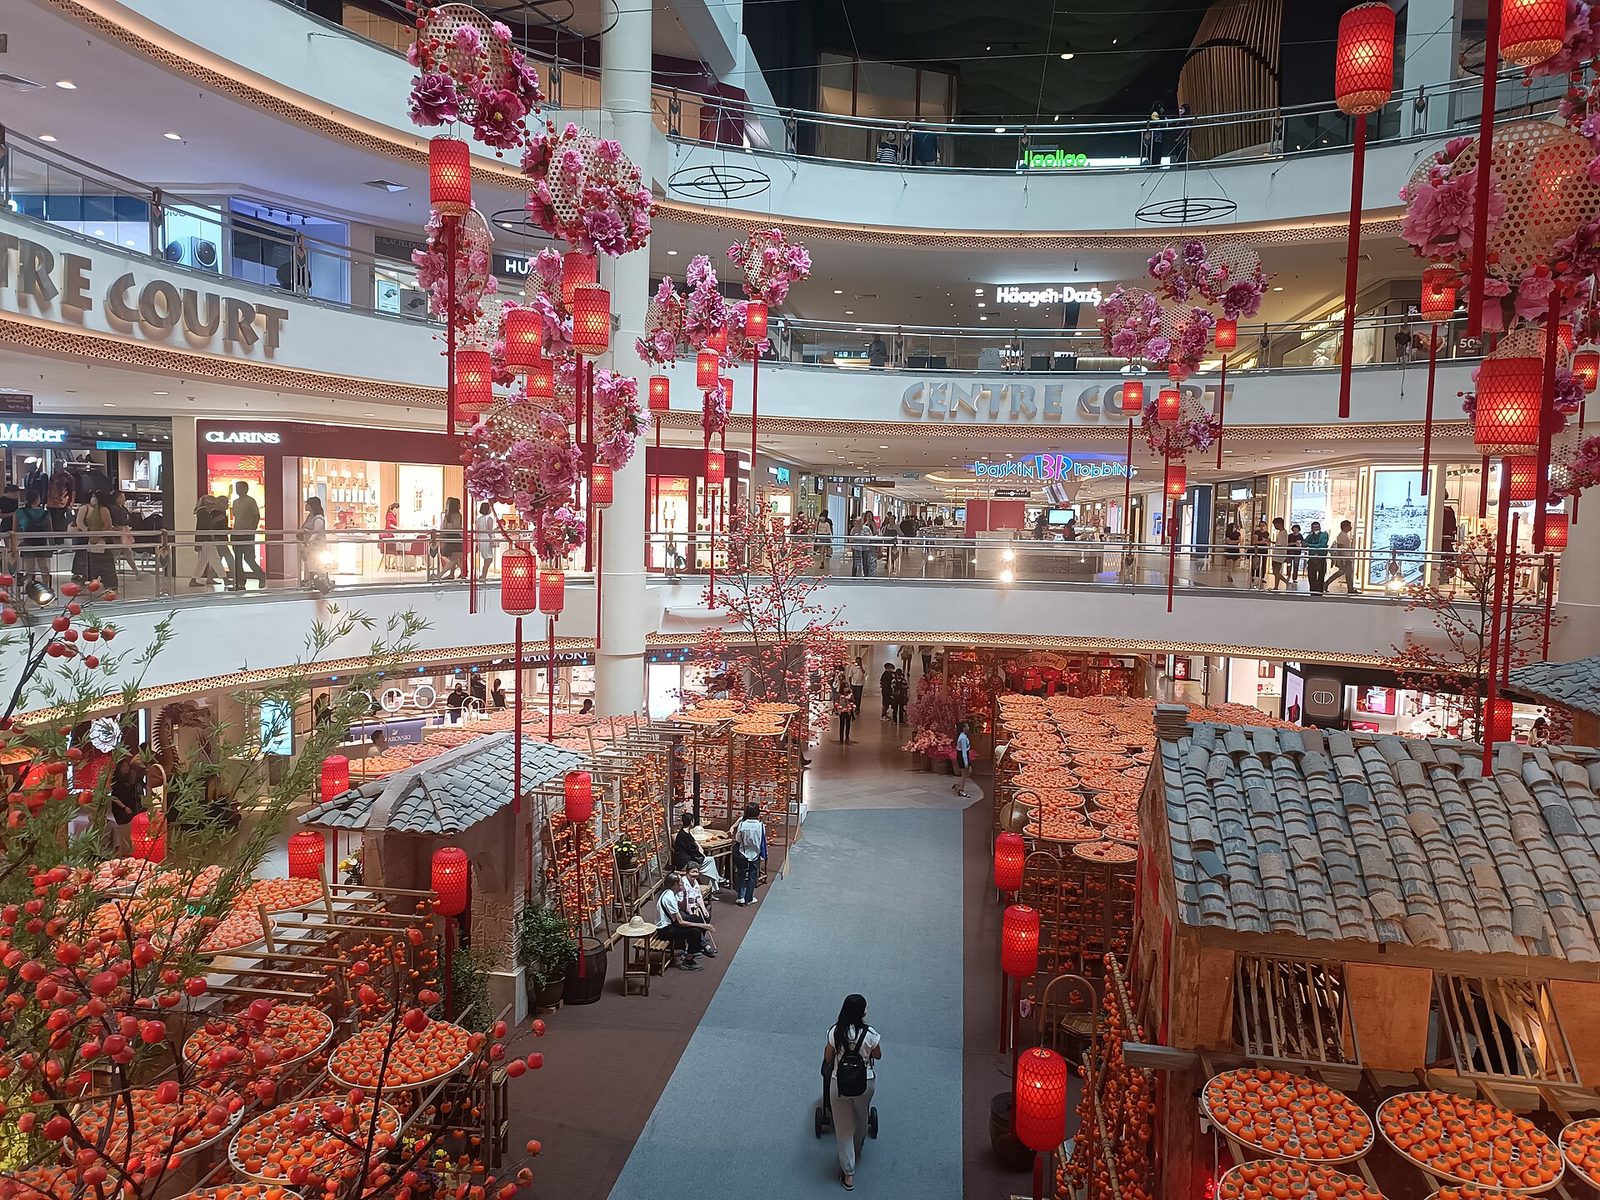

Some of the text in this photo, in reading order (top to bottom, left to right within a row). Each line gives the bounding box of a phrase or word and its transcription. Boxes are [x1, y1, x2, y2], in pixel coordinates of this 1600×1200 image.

[1024, 149, 1088, 168] llaollao
[104, 272, 289, 355] COURT
[901, 381, 1064, 418] CENTRE
[0, 423, 65, 442] Master
[205, 431, 281, 444] CLARINS
[974, 461, 1034, 479] baskin
[1035, 454, 1073, 481] BR
